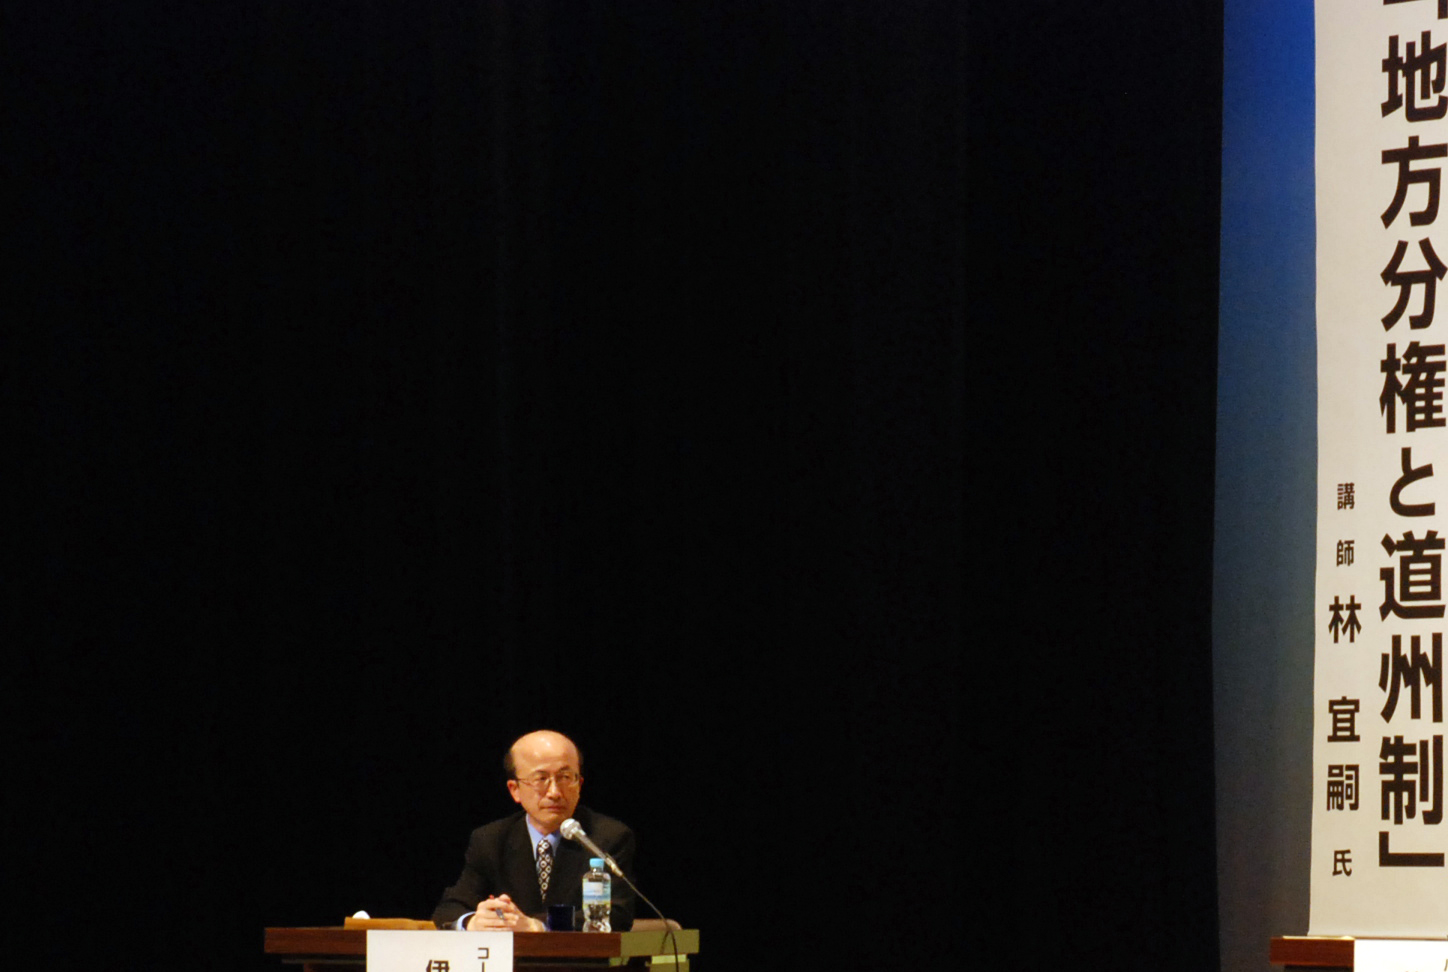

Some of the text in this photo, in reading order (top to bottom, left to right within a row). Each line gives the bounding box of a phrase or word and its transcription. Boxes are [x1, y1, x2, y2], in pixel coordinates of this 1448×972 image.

[1326, 482, 1362, 877] 講師 林 宜嗣 氏
